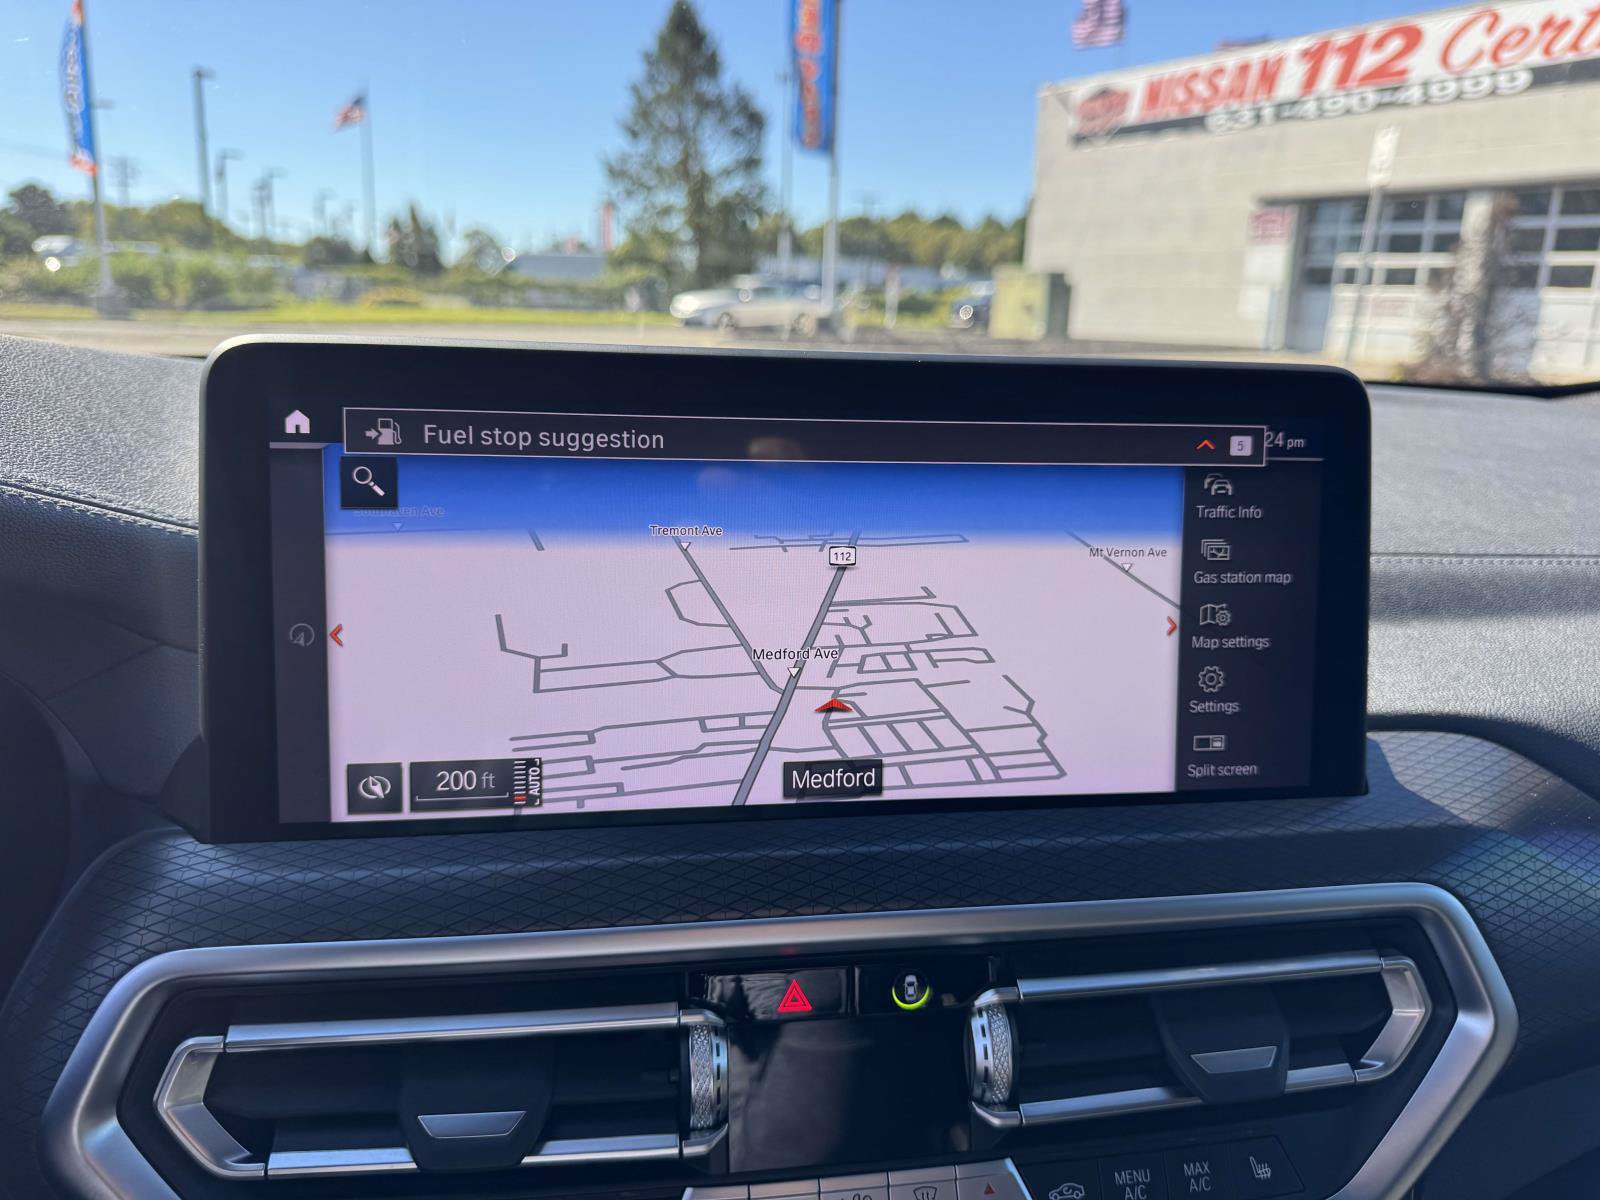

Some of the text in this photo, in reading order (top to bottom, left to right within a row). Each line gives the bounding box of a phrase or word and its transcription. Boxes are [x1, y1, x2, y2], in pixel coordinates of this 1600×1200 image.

[1139, 52, 1288, 122] NISSAN
[1296, 22, 1424, 97] 112
[423, 423, 665, 453] Fuel stop suggestion
[1286, 438, 1305, 451] pm
[1236, 440, 1244, 452] 5
[1196, 505, 1262, 519] Traffic Info
[650, 525, 723, 536] Tremont Ave
[833, 551, 852, 562] 112
[1089, 547, 1167, 558] Mt Vernon Ave
[1194, 571, 1291, 587] Gas station map
[1191, 635, 1270, 650] Map settings
[752, 648, 838, 660] Medford Ave
[1189, 700, 1240, 715] Settings
[792, 768, 876, 789] Medford
[1187, 763, 1257, 779] Split screen
[436, 769, 496, 791] 200 ft
[528, 767, 541, 796] AUTO
[1183, 1161, 1211, 1176] MAX
[1114, 1169, 1150, 1185] MENU
[1189, 1176, 1212, 1193] A/C
[1124, 1185, 1147, 1200] A/C
